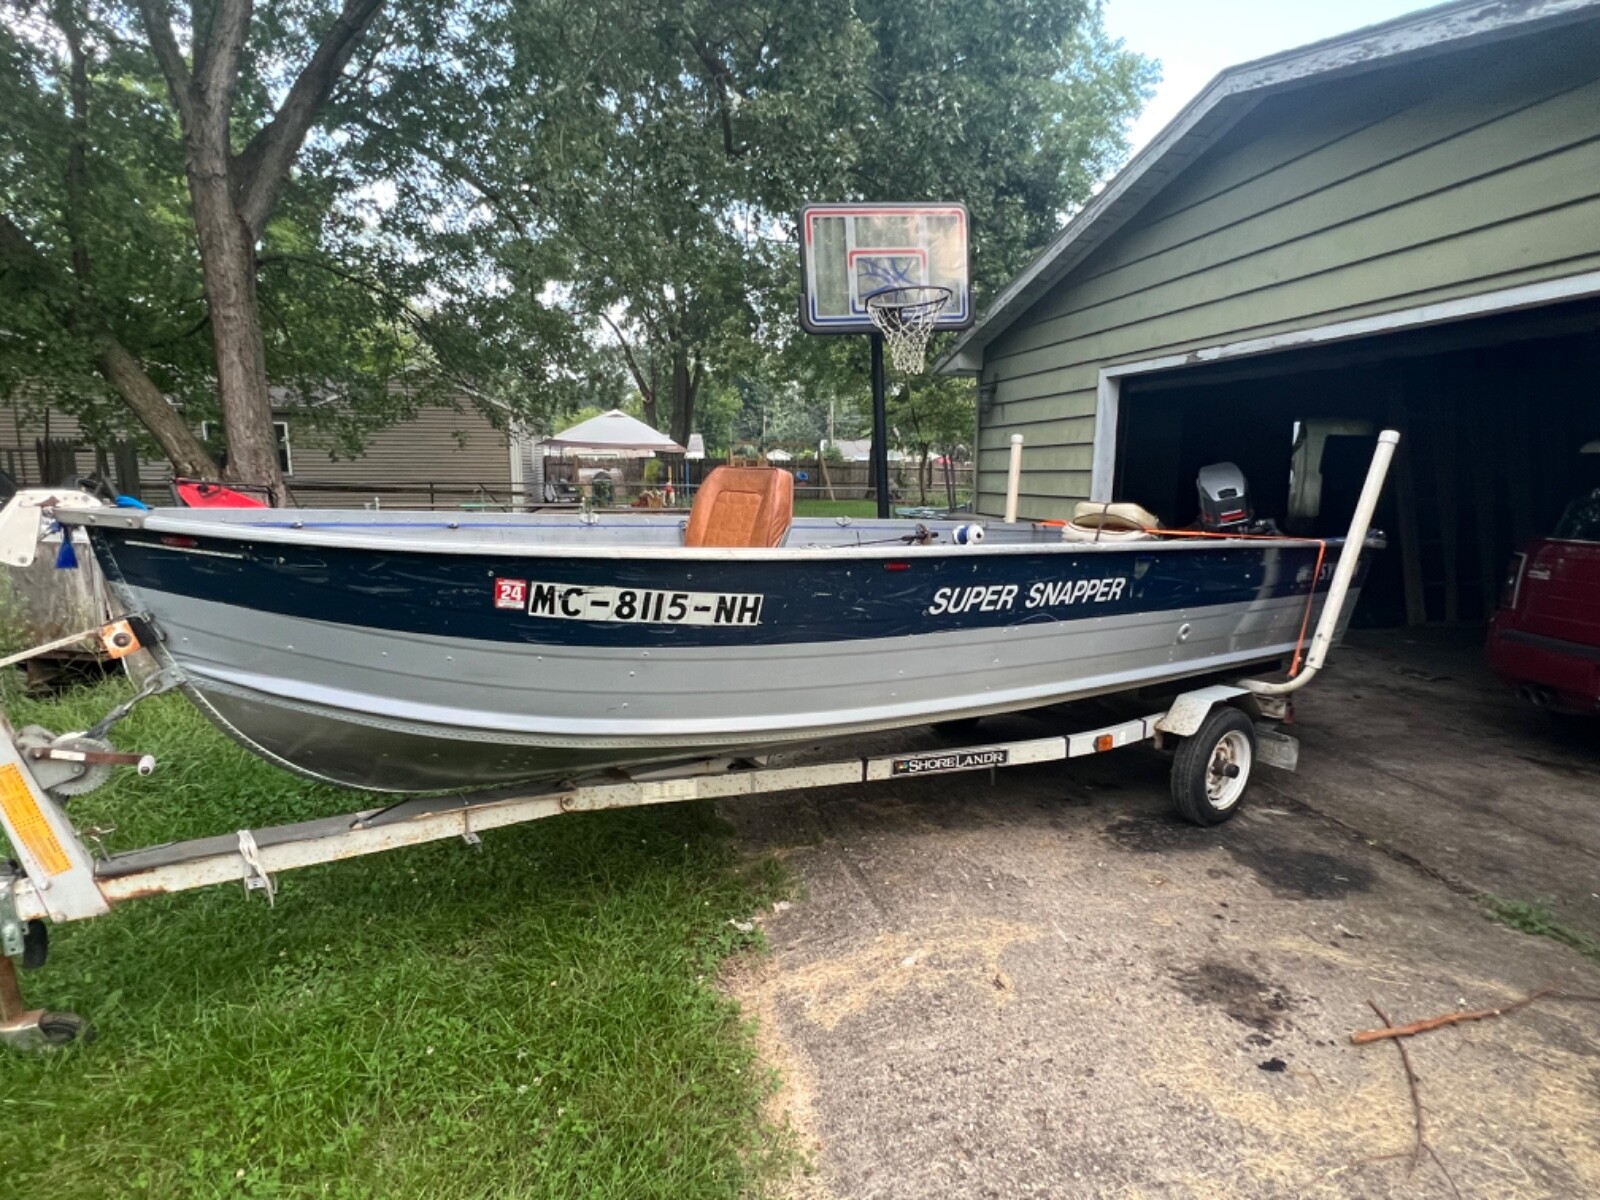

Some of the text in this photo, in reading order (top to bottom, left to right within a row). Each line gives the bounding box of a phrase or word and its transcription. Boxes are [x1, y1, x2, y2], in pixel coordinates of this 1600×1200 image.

[501, 585, 523, 602] 24
[928, 577, 1126, 615] SUPER SNAPPER
